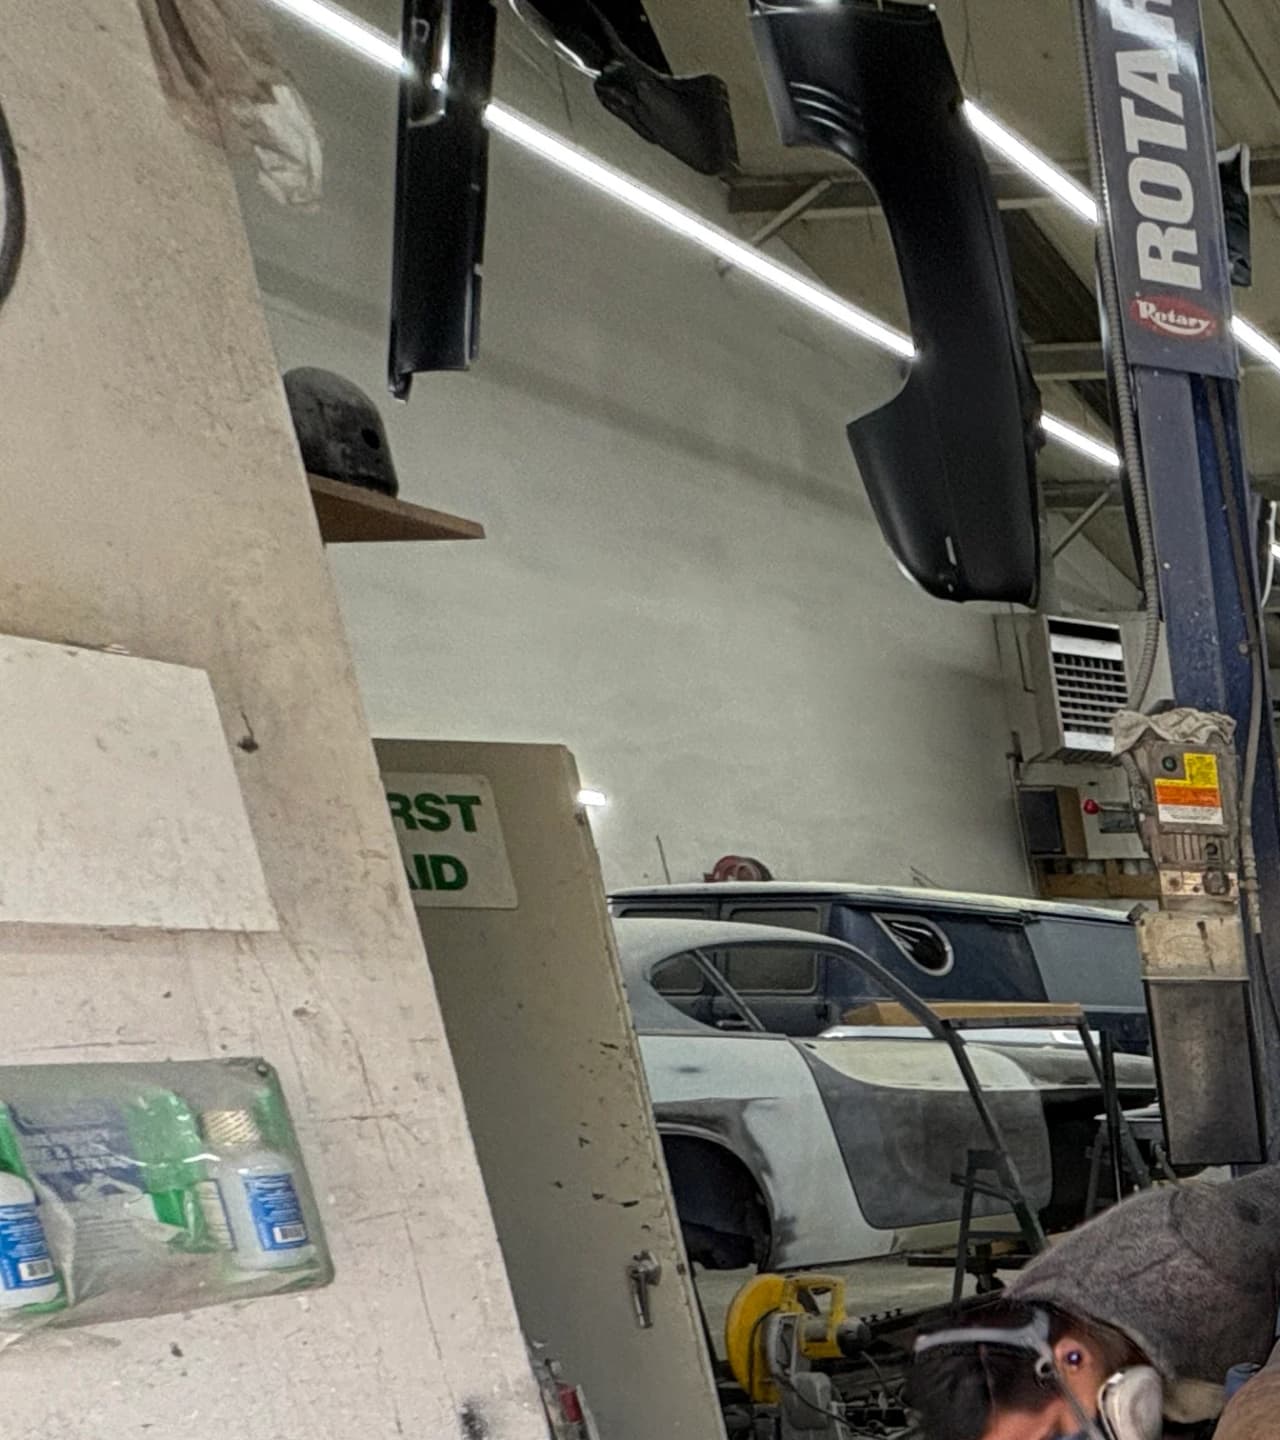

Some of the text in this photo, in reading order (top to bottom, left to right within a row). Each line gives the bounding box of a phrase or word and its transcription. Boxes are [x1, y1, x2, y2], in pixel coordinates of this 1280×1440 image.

[1136, 298, 1211, 336] Rotary
[386, 792, 482, 832] RST
[407, 853, 469, 890] ID
